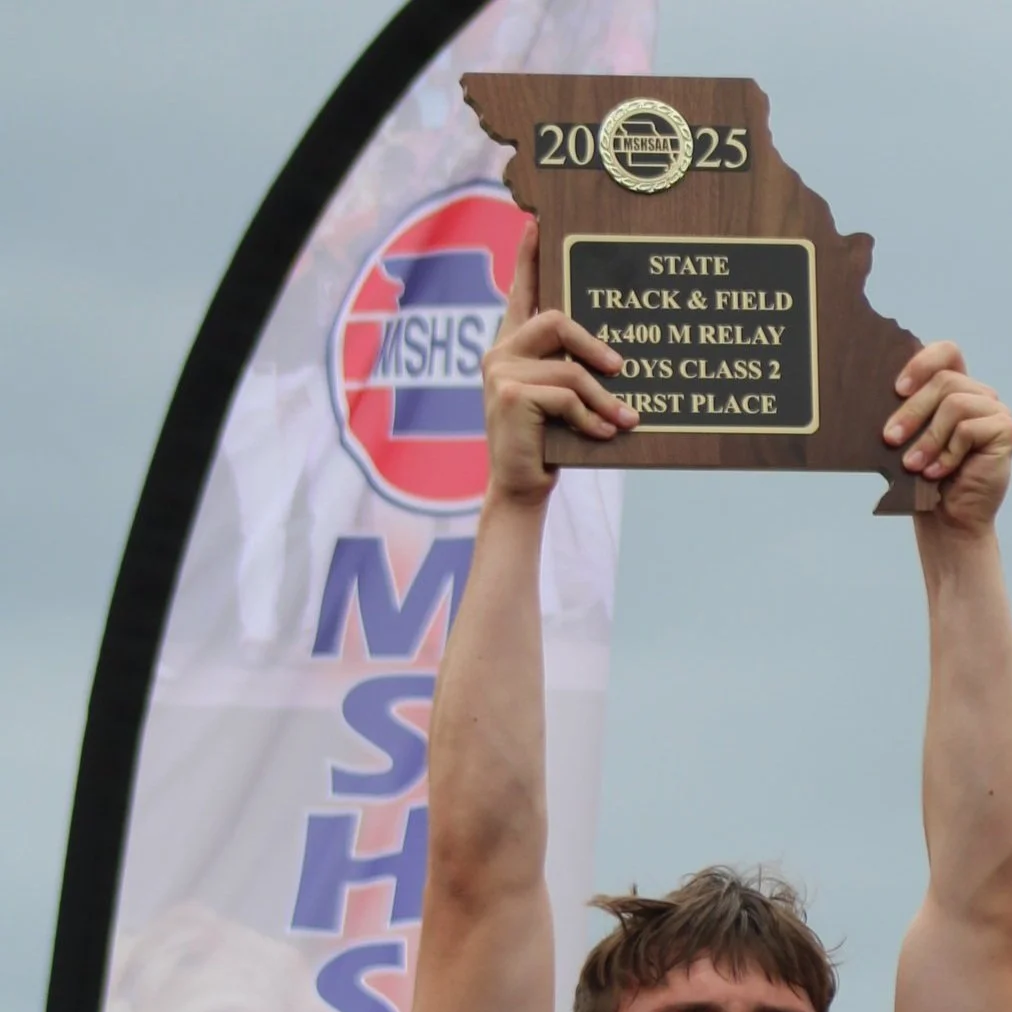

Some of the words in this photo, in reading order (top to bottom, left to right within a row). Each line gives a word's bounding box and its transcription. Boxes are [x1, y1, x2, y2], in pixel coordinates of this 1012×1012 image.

[540, 126, 594, 165] 20
[623, 137, 669, 151] MSHSAA
[695, 128, 748, 168] 25
[649, 256, 729, 276] STATE
[588, 289, 680, 310] TRACK
[687, 290, 708, 310] &
[716, 290, 793, 311] FIELD
[374, 314, 506, 377] MSHS
[597, 324, 661, 344] 4x400
[668, 325, 692, 344] M
[699, 325, 786, 346] RELAY
[611, 359, 673, 379] OYS
[679, 359, 762, 380] CLASS
[769, 361, 781, 379] 2
[692, 394, 778, 414] PLACE
